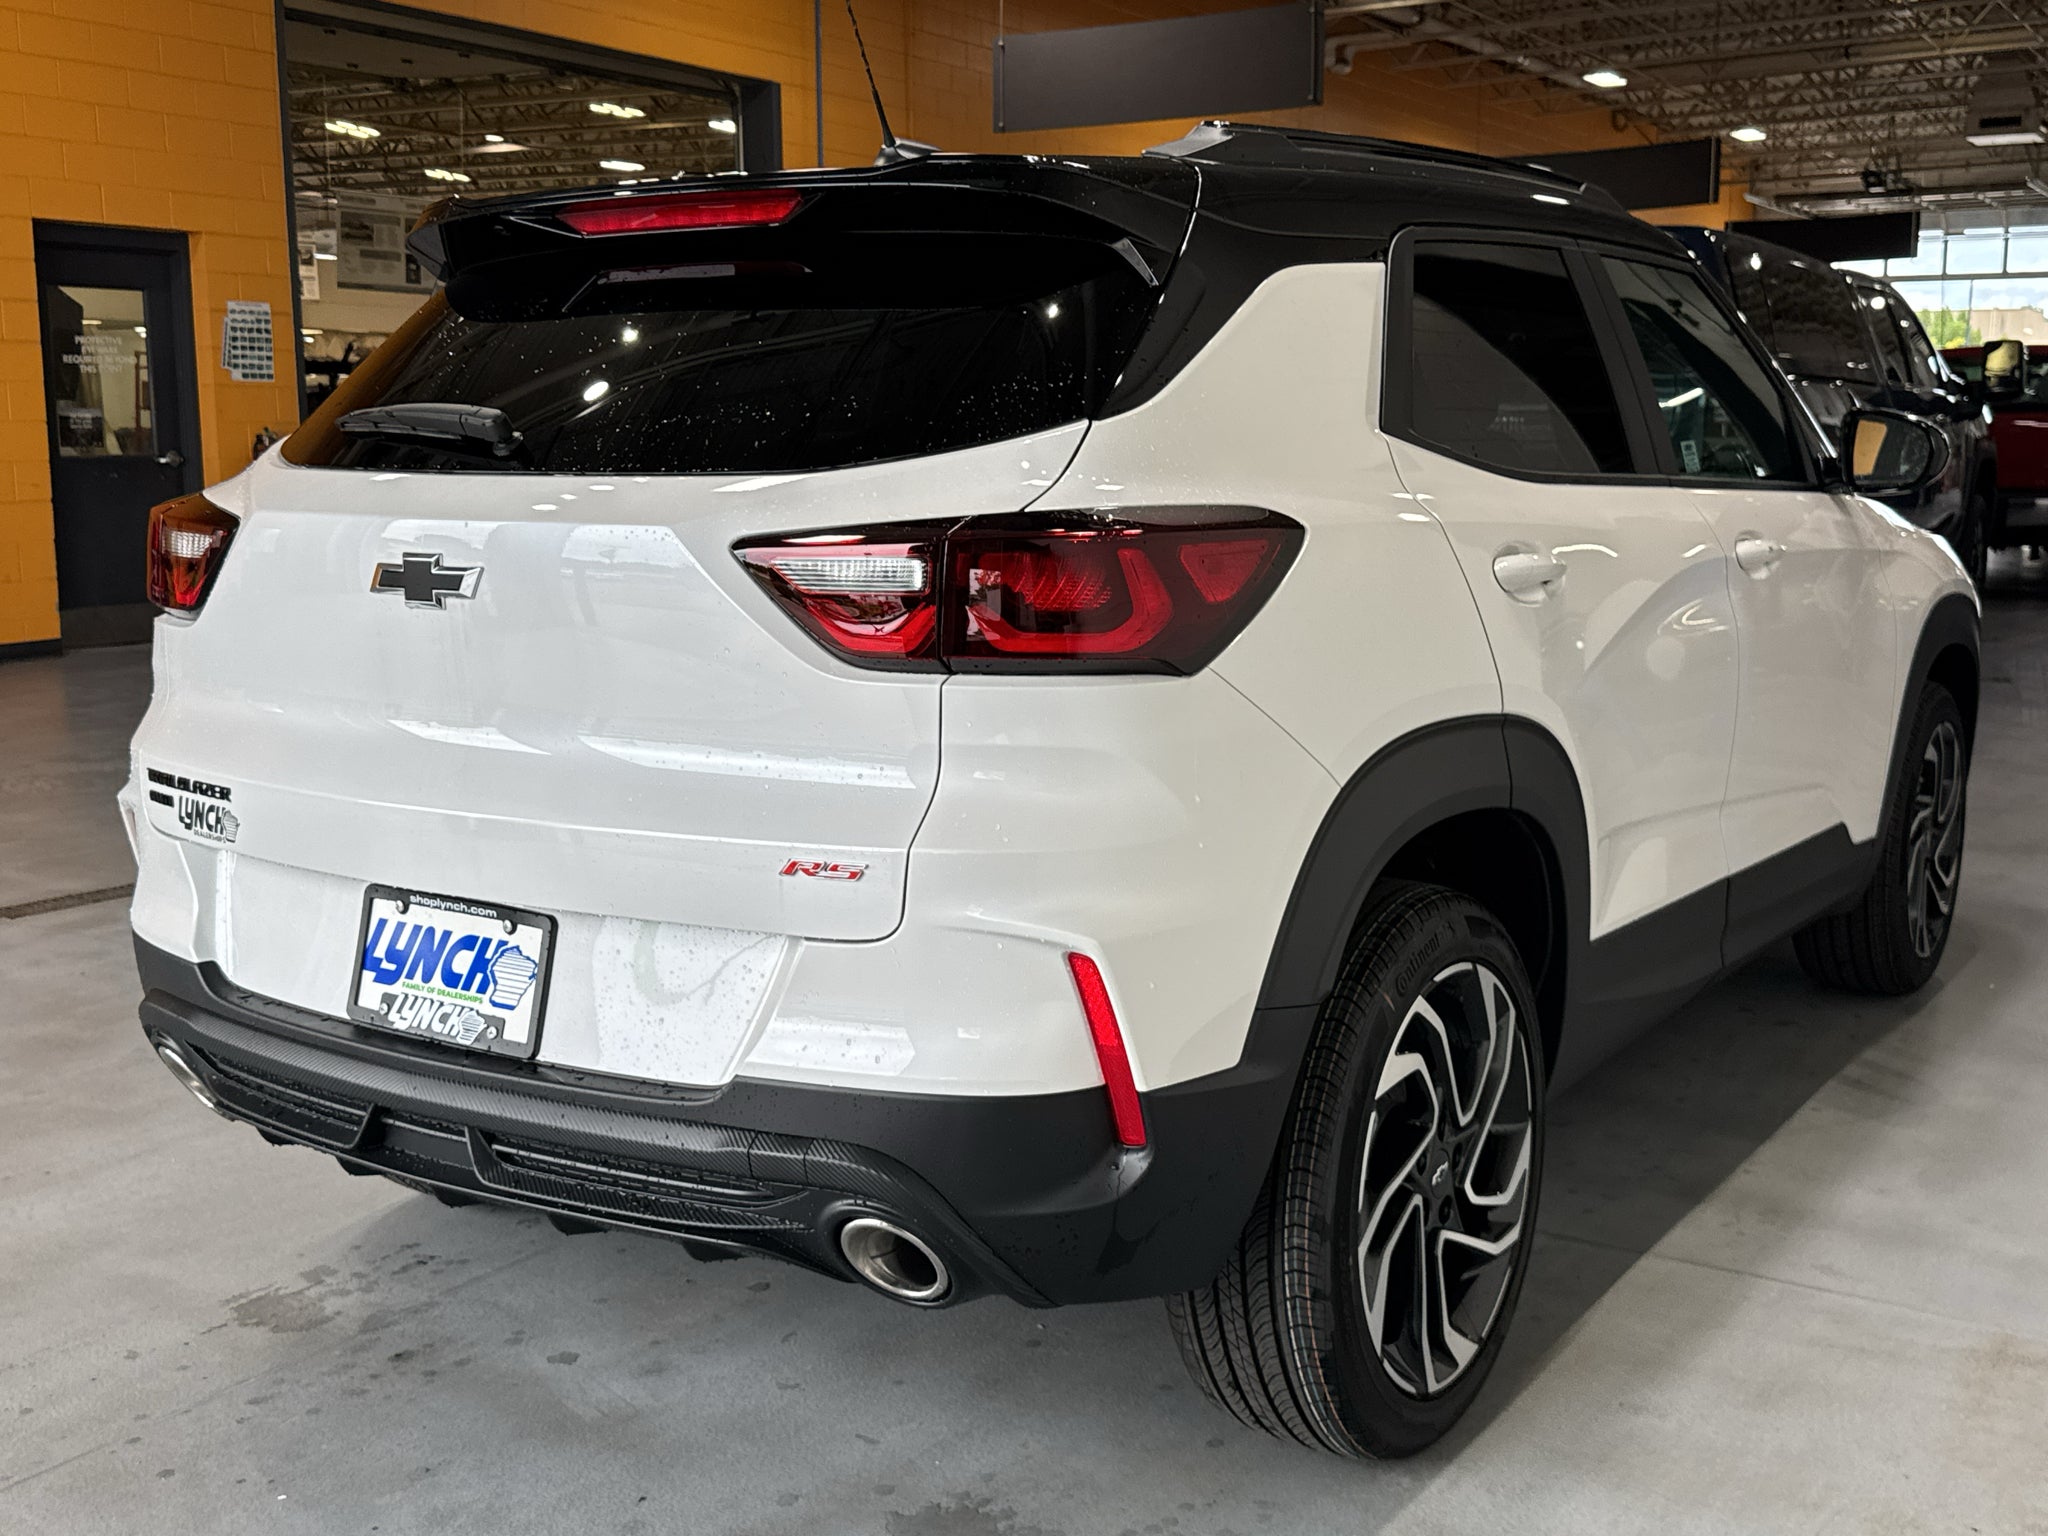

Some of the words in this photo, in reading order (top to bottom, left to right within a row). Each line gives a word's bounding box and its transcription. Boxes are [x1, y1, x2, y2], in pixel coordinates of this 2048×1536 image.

[179, 796, 227, 835] LYNCH
[779, 858, 869, 882] RS
[409, 894, 498, 918] shoplynch.com
[363, 918, 509, 995] LYNCH
[402, 981, 426, 992] FAMILY
[427, 985, 437, 994] OF
[437, 987, 484, 1004] DEALERSHIPS
[387, 992, 473, 1037] LYNCH
